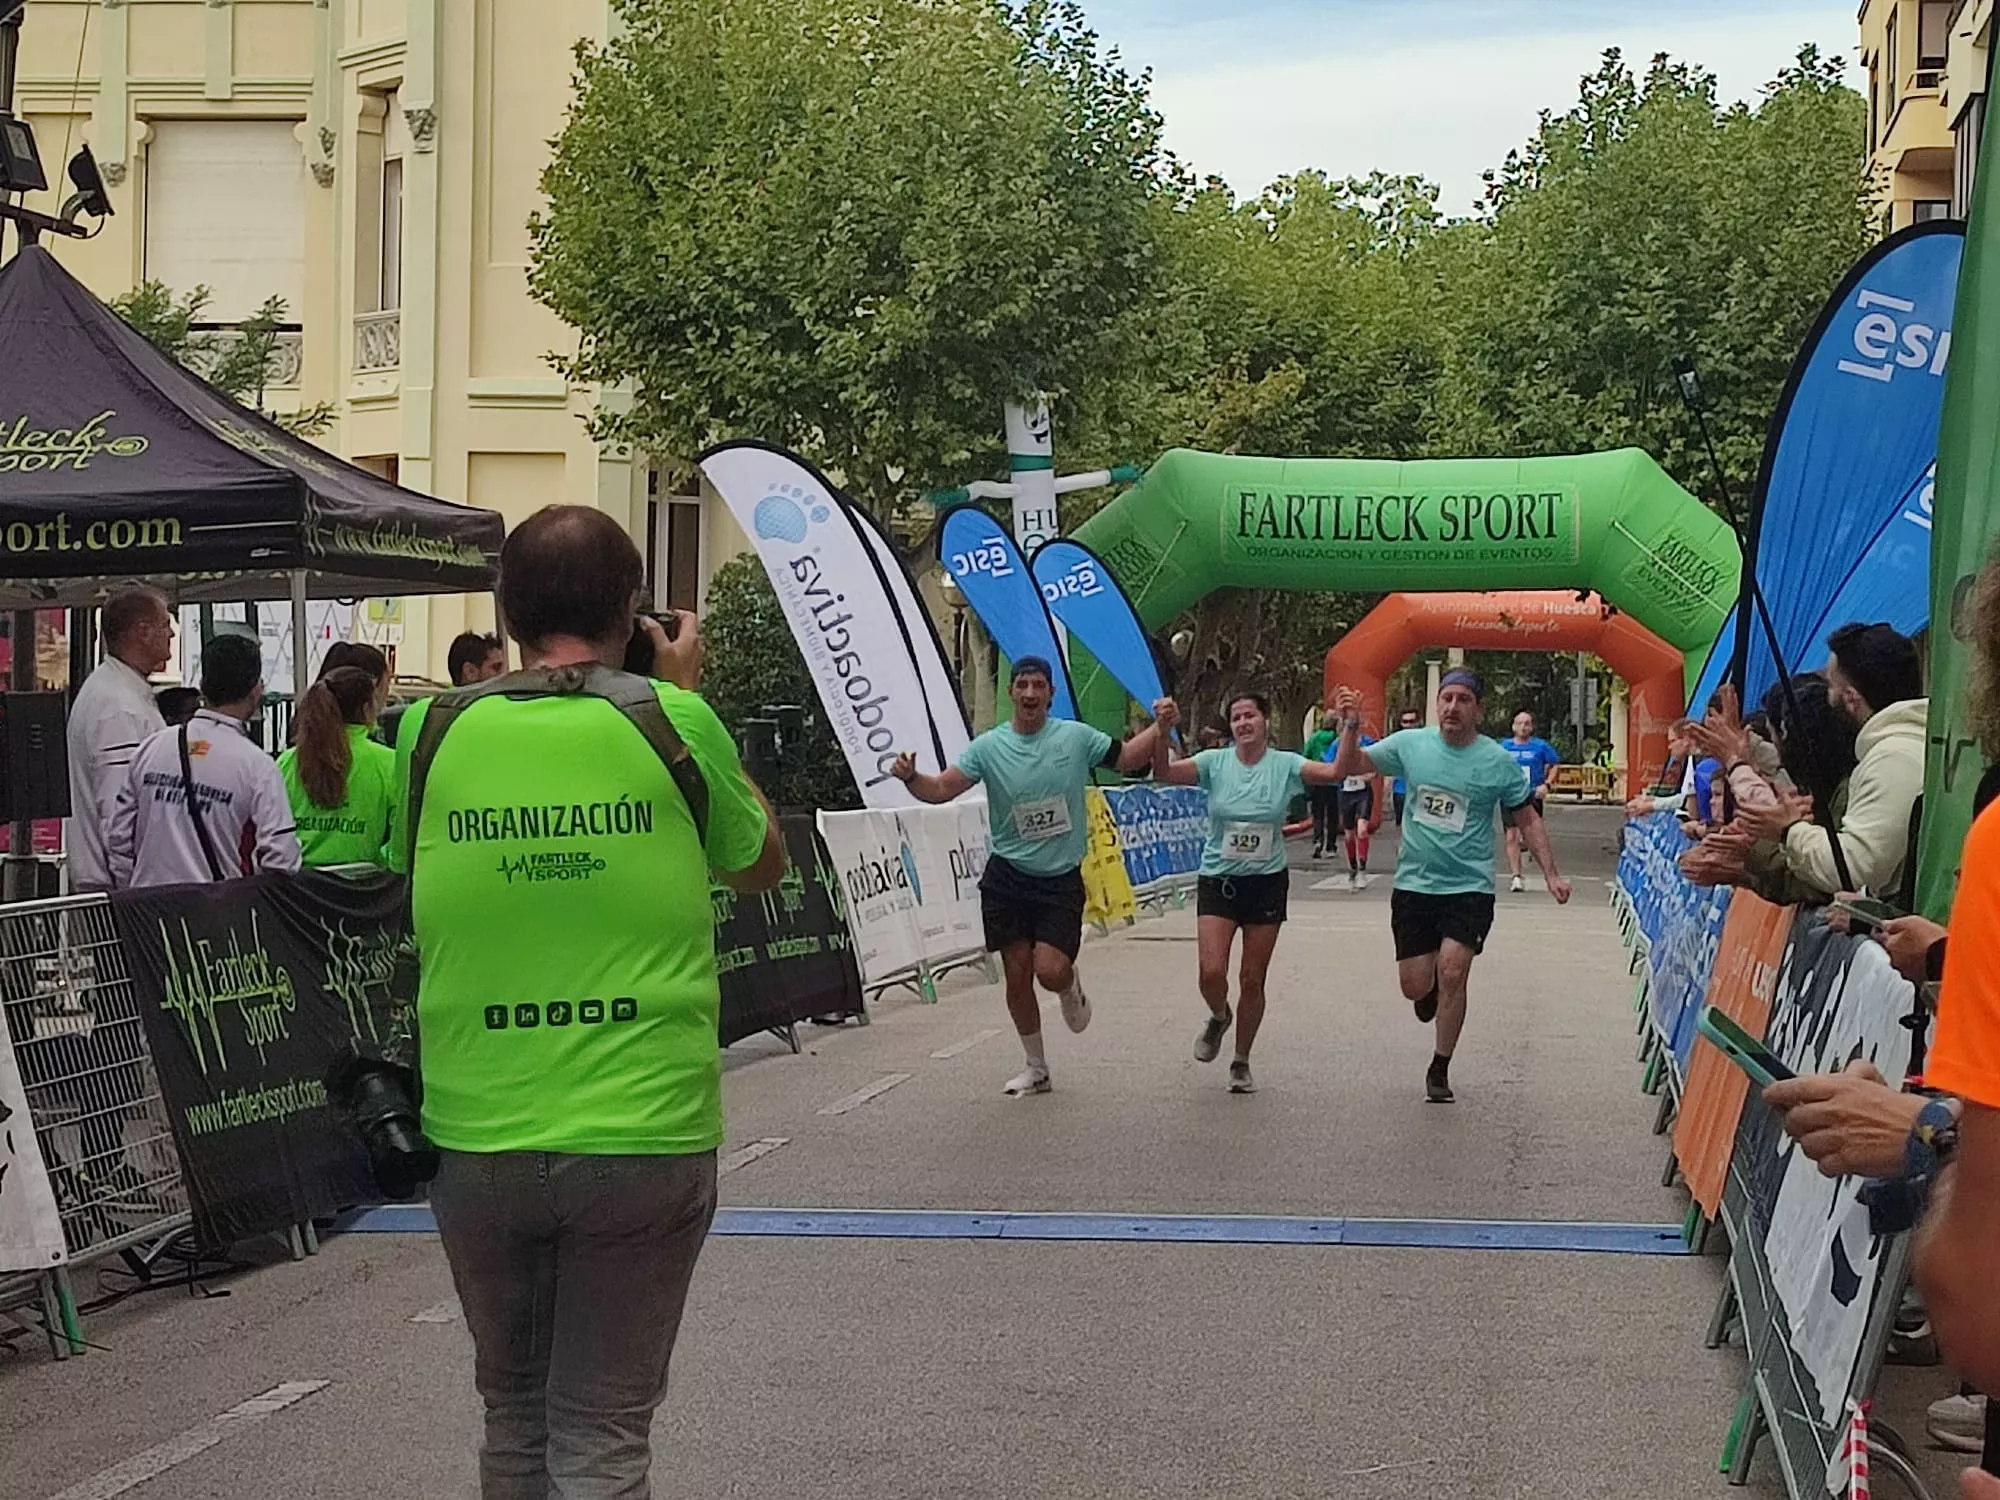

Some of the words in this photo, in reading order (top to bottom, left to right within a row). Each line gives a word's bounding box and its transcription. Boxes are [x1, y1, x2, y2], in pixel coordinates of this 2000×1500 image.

[1237, 492, 1429, 542] FARTLECK
[1439, 493, 1562, 542] SPORT
[0, 511, 183, 552] ort.com
[1366, 549, 1375, 561] Y
[1453, 548, 1474, 561] DE
[1479, 546, 1554, 560] EVENTOS
[1423, 796, 1456, 815] 328
[448, 793, 653, 844] ORGANIZACIÓN
[1024, 810, 1055, 828] 327
[1229, 833, 1261, 850] 329
[534, 868, 592, 882] SPORT
